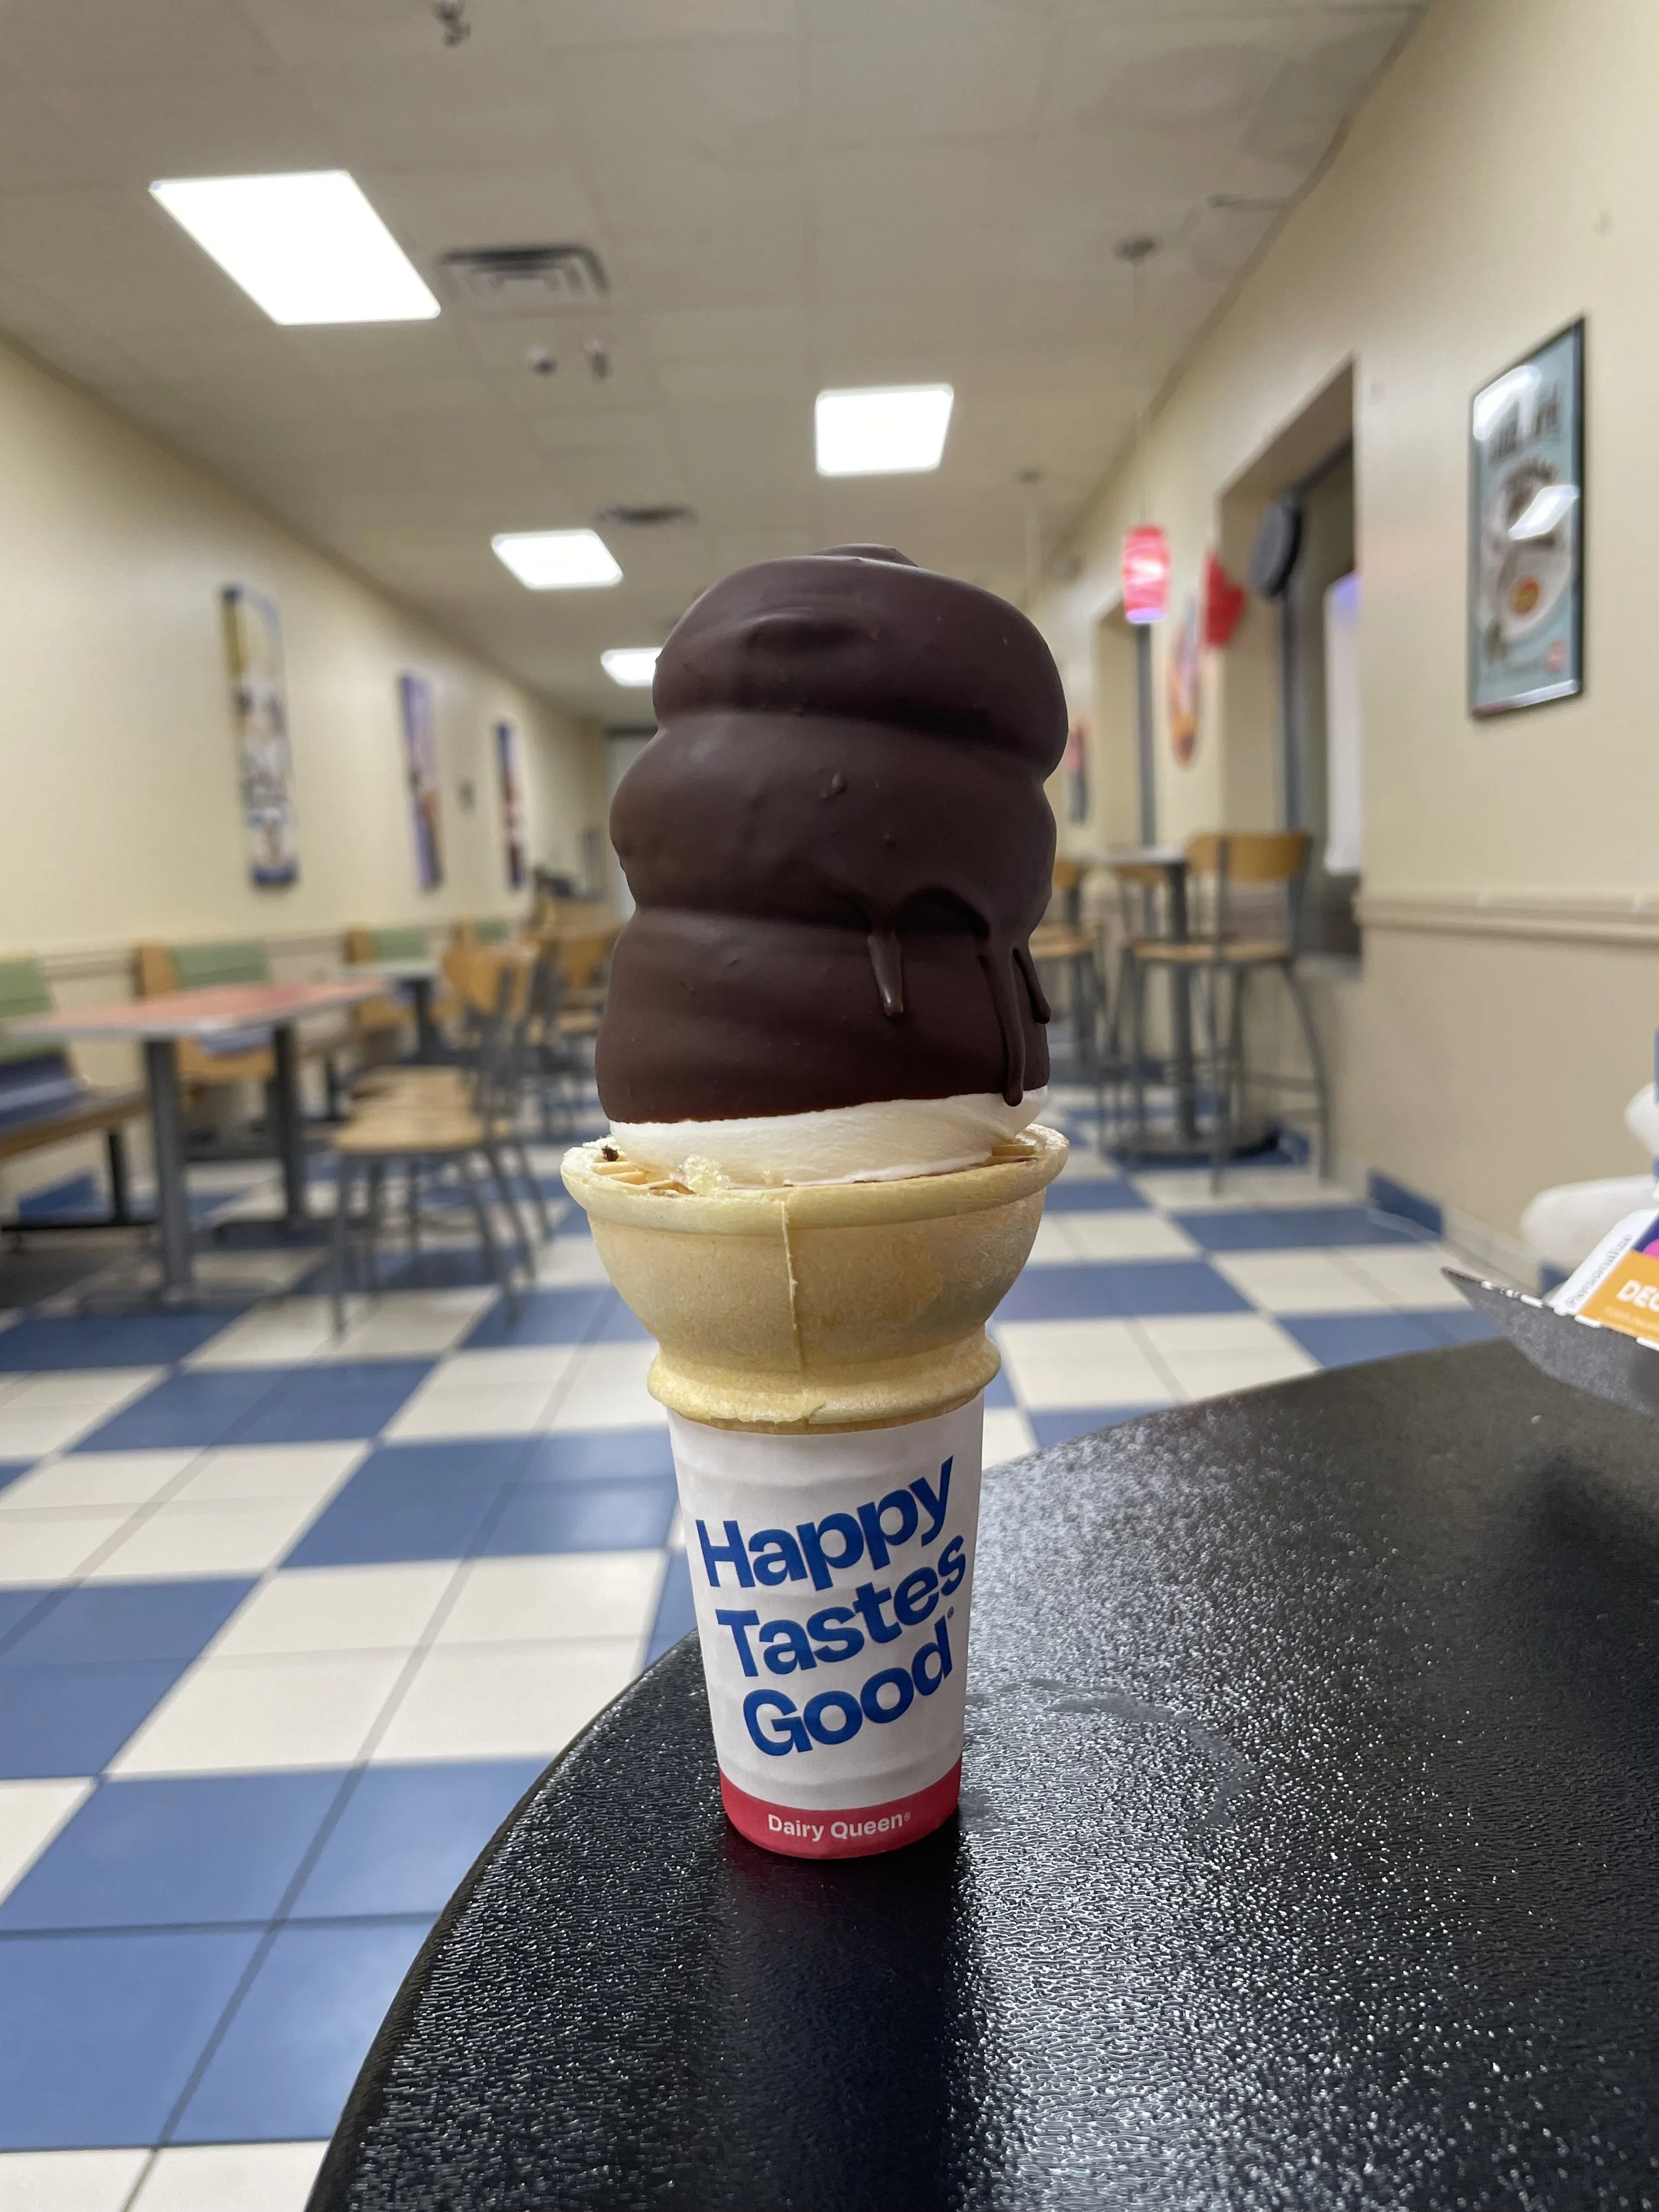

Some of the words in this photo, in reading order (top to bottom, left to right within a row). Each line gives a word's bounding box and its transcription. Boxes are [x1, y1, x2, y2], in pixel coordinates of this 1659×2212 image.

[695, 1455, 954, 1591] Happy
[715, 1534, 966, 1677] Tastes
[743, 1620, 954, 1757] Good
[768, 1814, 824, 1842] Dairy
